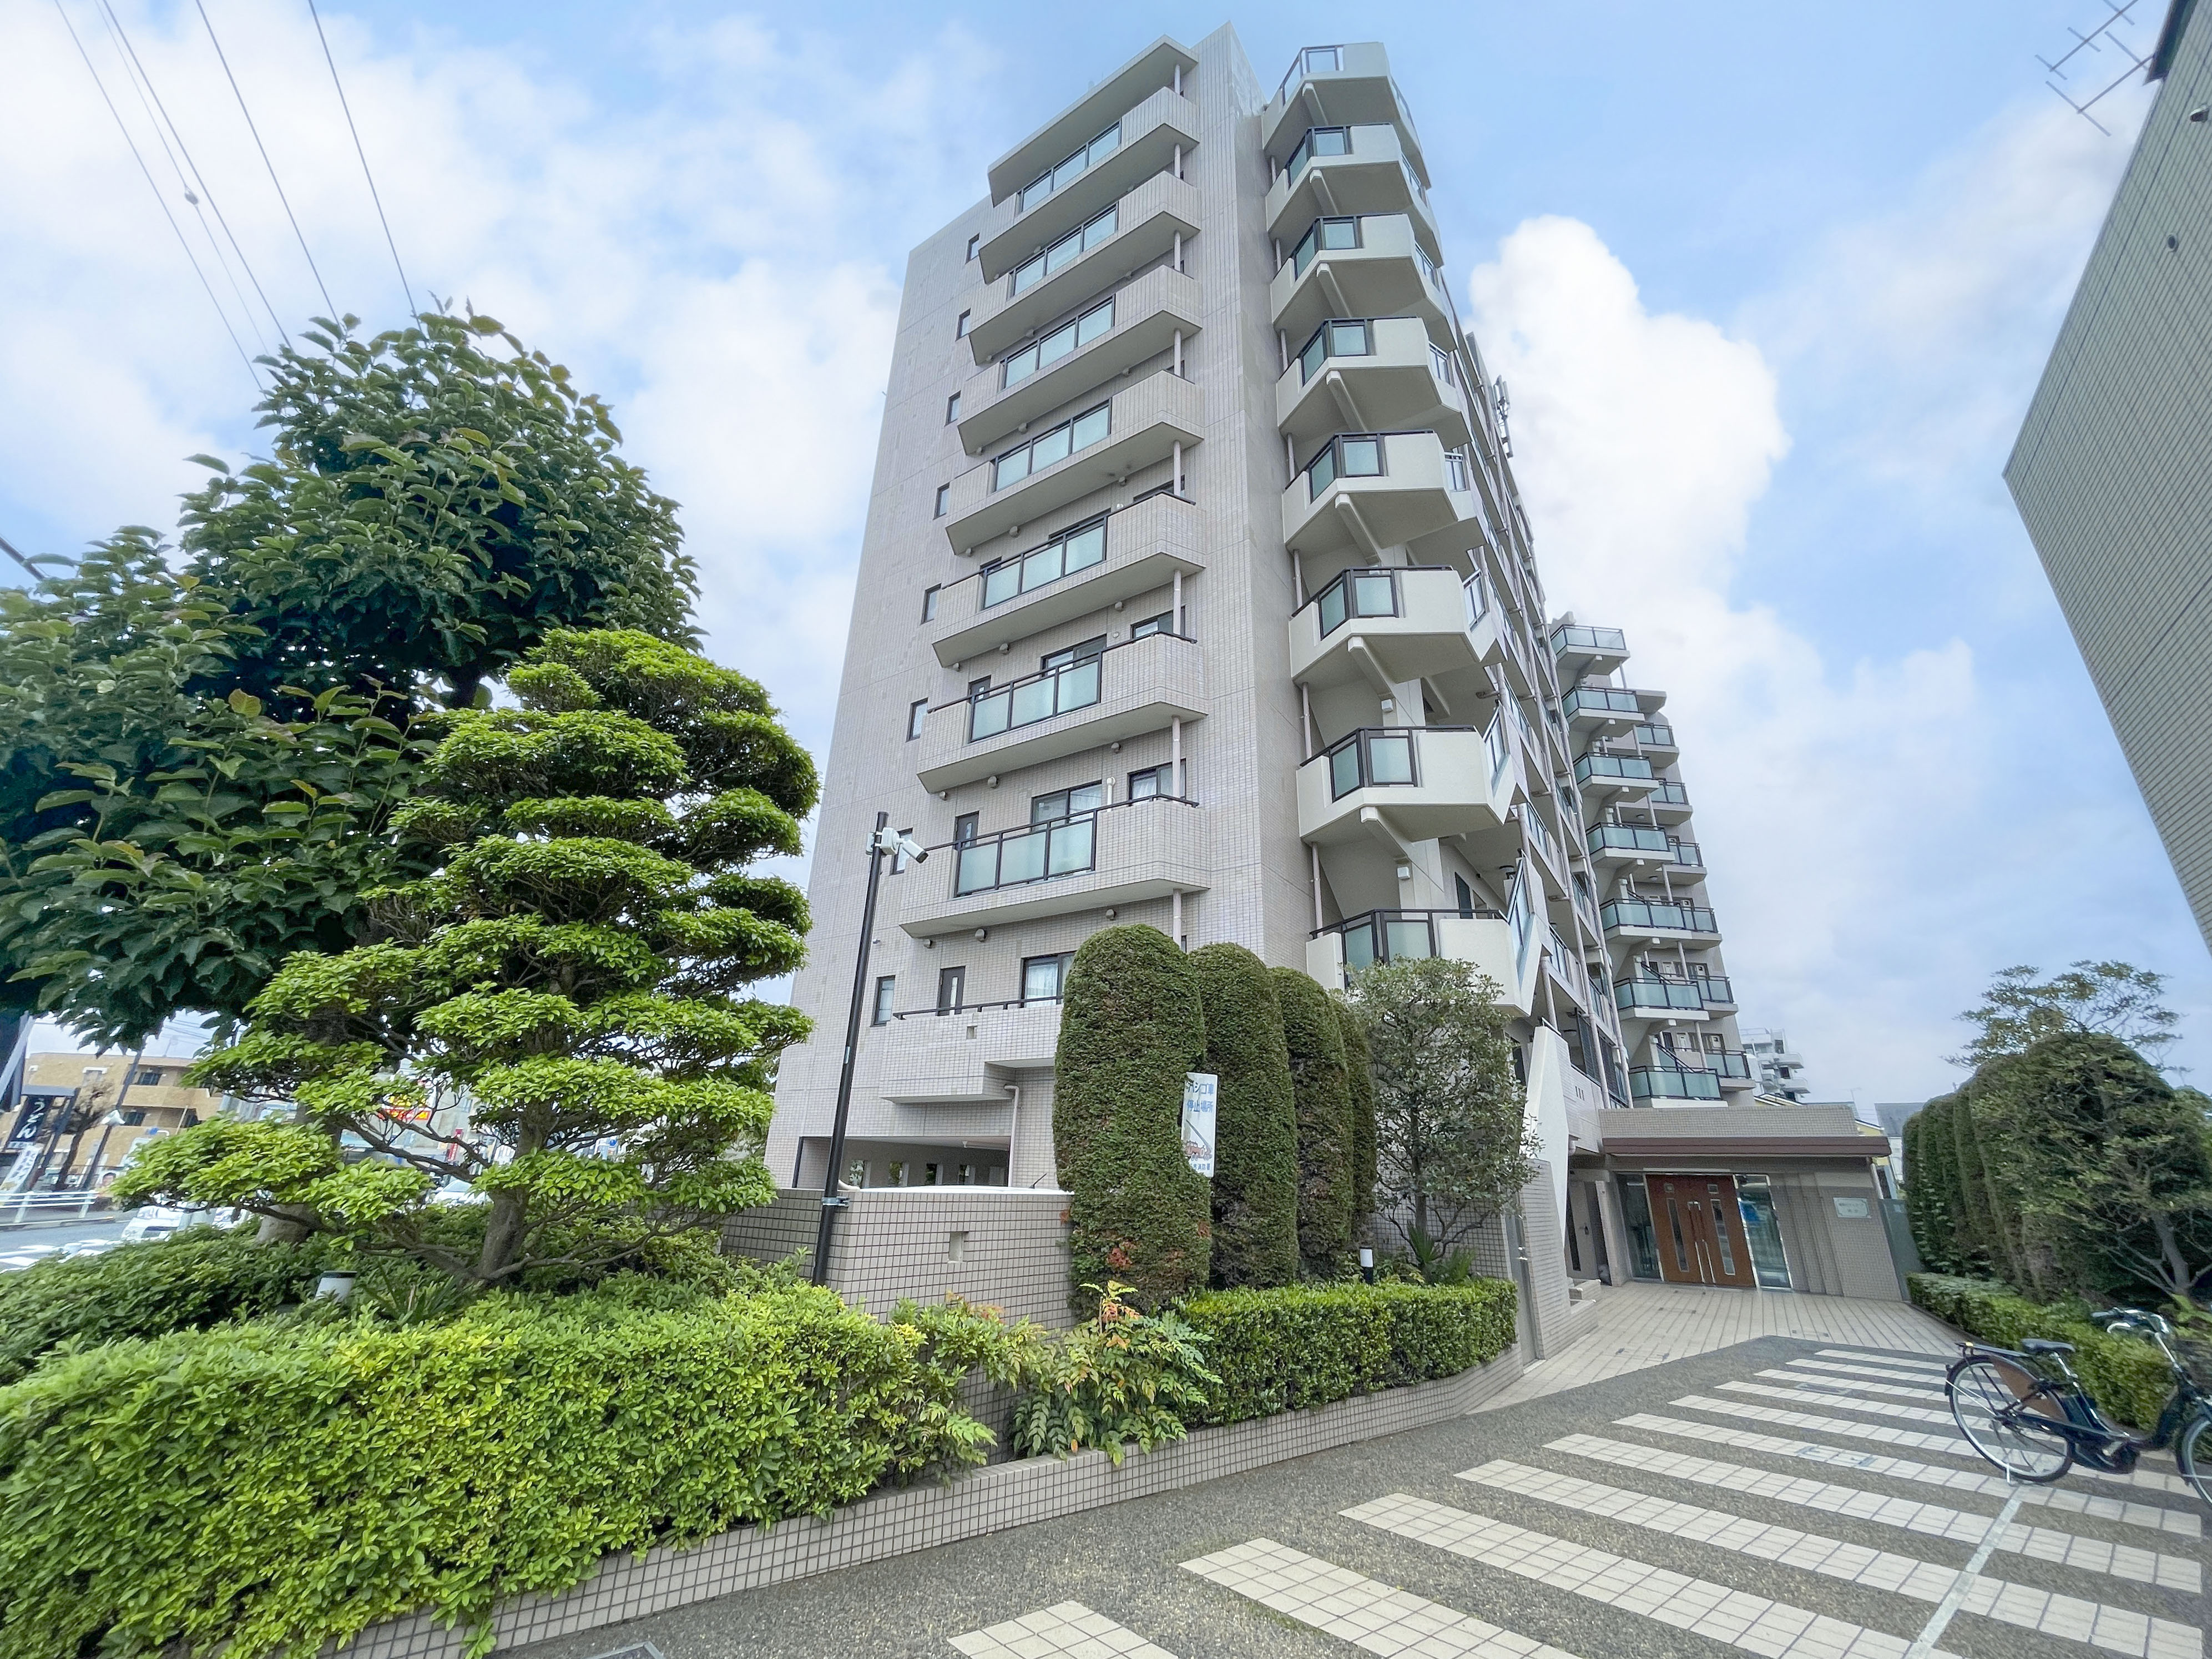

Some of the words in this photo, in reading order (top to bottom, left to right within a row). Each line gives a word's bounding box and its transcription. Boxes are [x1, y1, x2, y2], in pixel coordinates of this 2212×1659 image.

[16, 1097, 46, 1139] うどん
[1187, 1100, 1214, 1113] 停止場所
